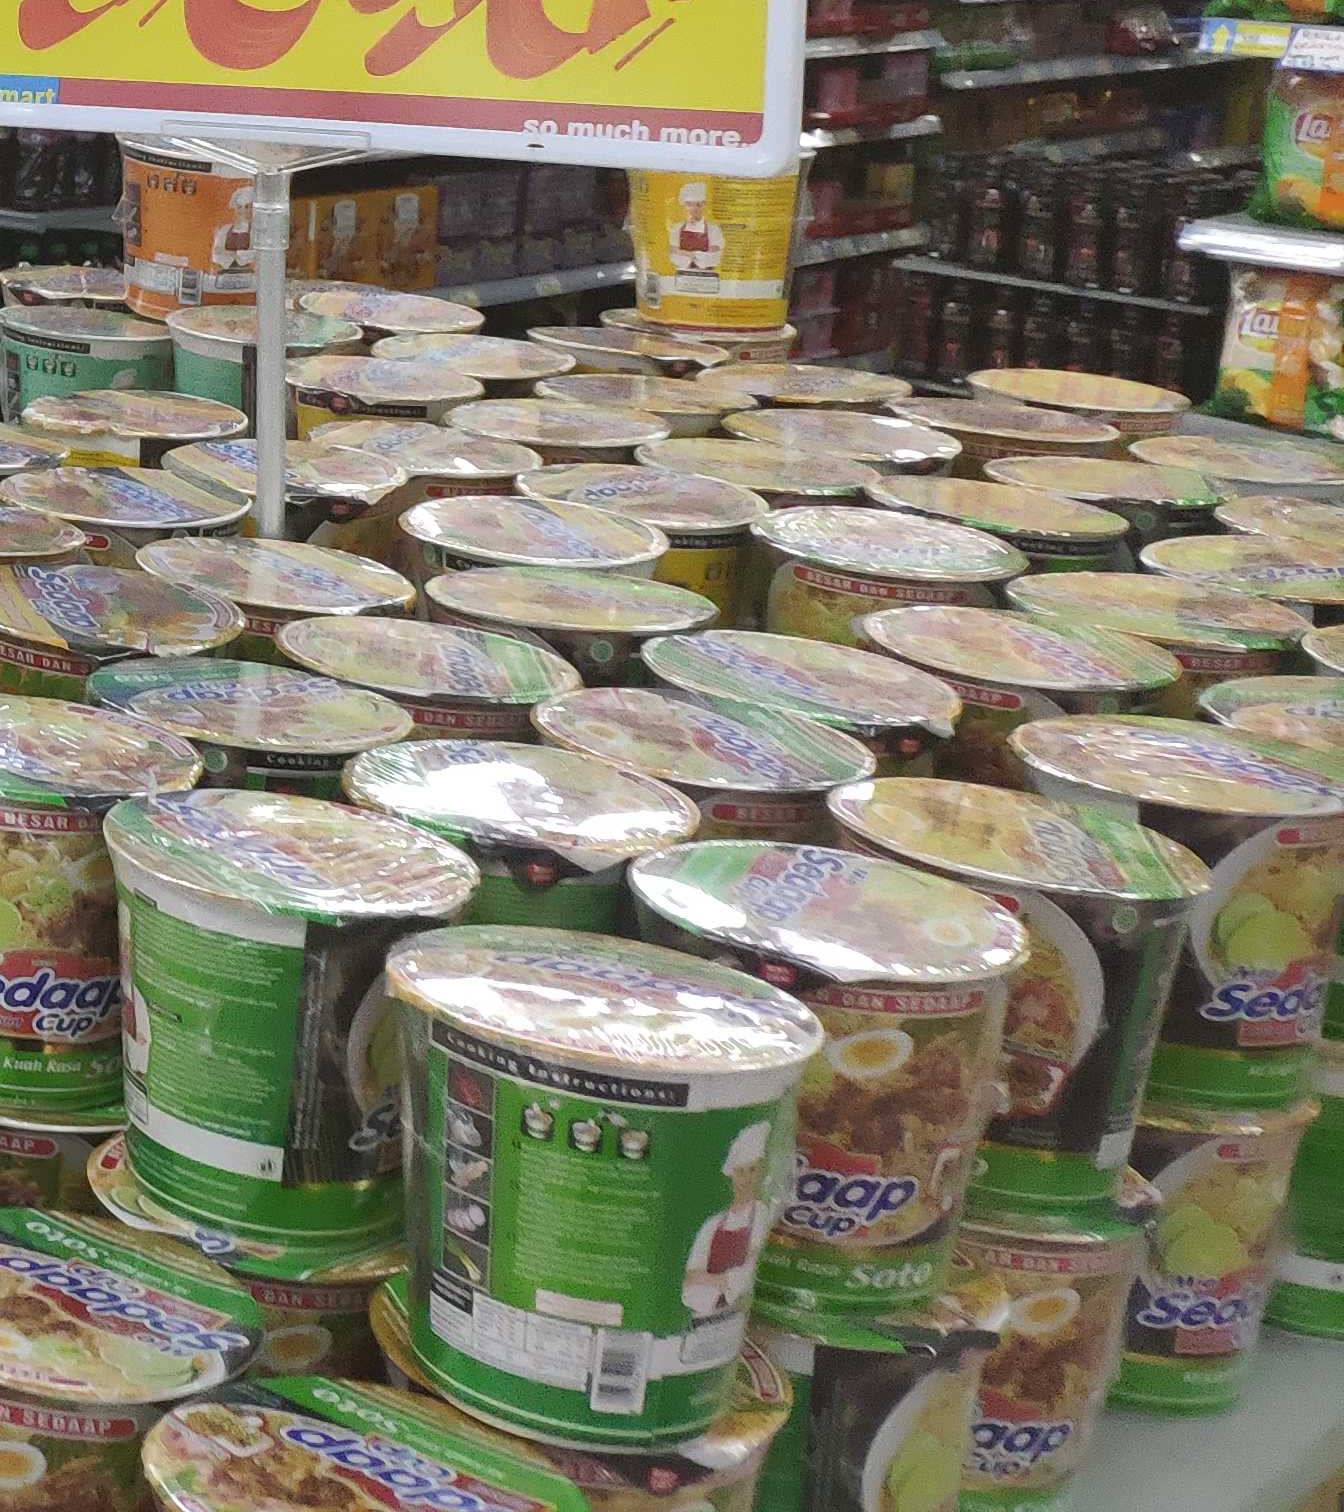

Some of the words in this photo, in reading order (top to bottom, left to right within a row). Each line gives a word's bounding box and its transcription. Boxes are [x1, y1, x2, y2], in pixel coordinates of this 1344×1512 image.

[523, 117, 558, 137] so
[567, 117, 652, 143] much
[42, 655, 72, 673] DAN
[3, 810, 69, 830] BESAR
[35, 1012, 94, 1038] Cup
[46, 1058, 82, 1074] Rasa
[796, 1172, 916, 1222] aap
[783, 1205, 856, 1237] Cup
[23, 1412, 111, 1437] SEDAAP
